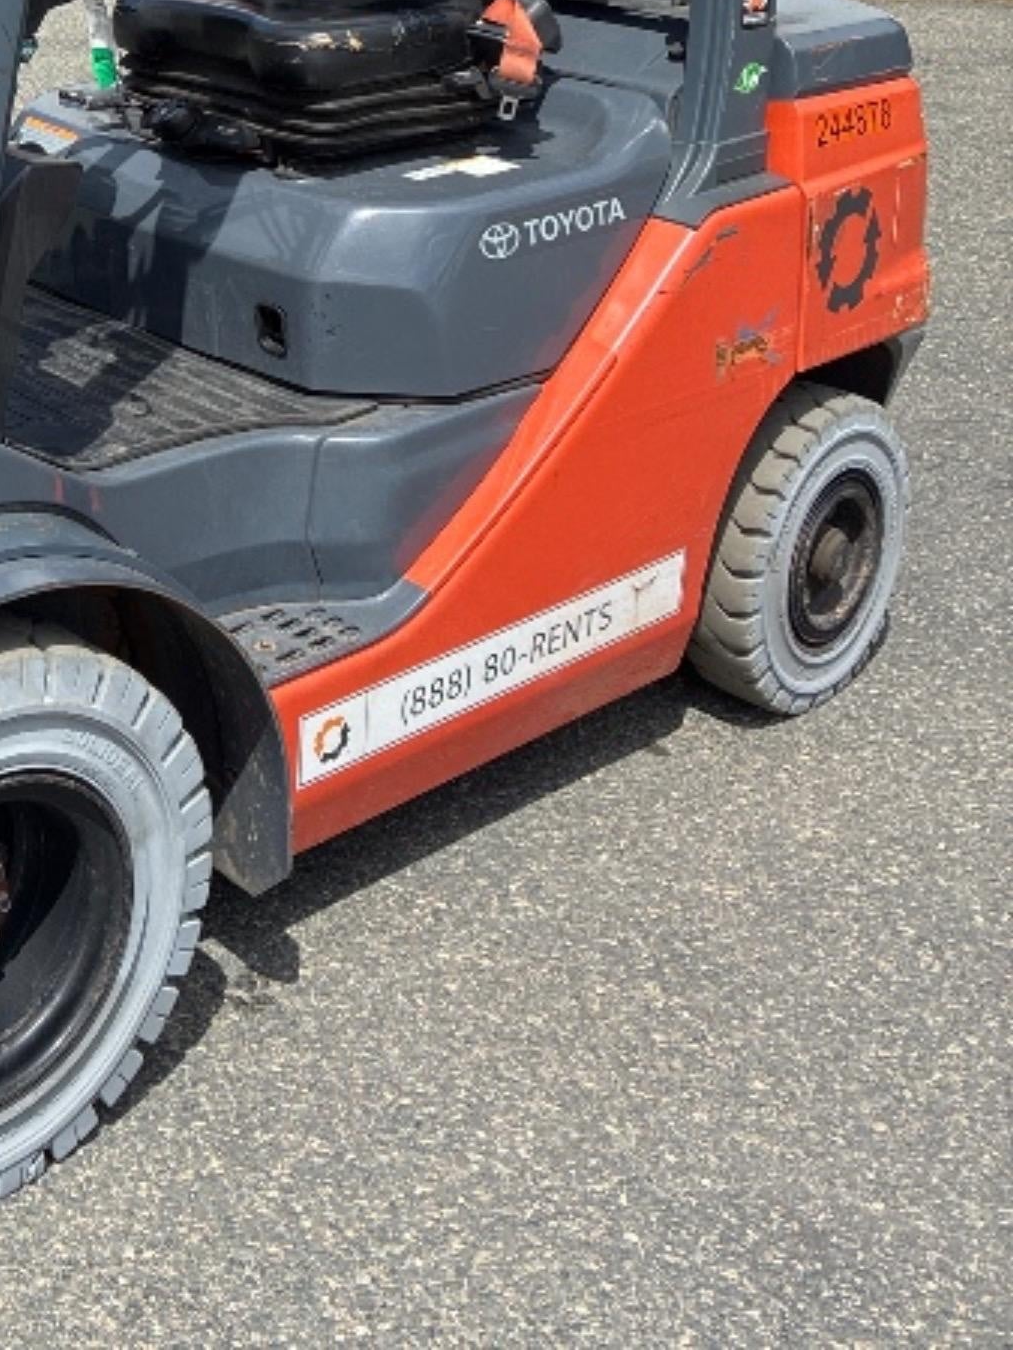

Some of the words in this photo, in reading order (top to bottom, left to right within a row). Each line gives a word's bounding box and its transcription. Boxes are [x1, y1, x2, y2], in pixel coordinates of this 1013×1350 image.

[523, 197, 626, 247] TOYOTA
[400, 663, 472, 726] (888)
[484, 599, 613, 685] 80-RENTS
